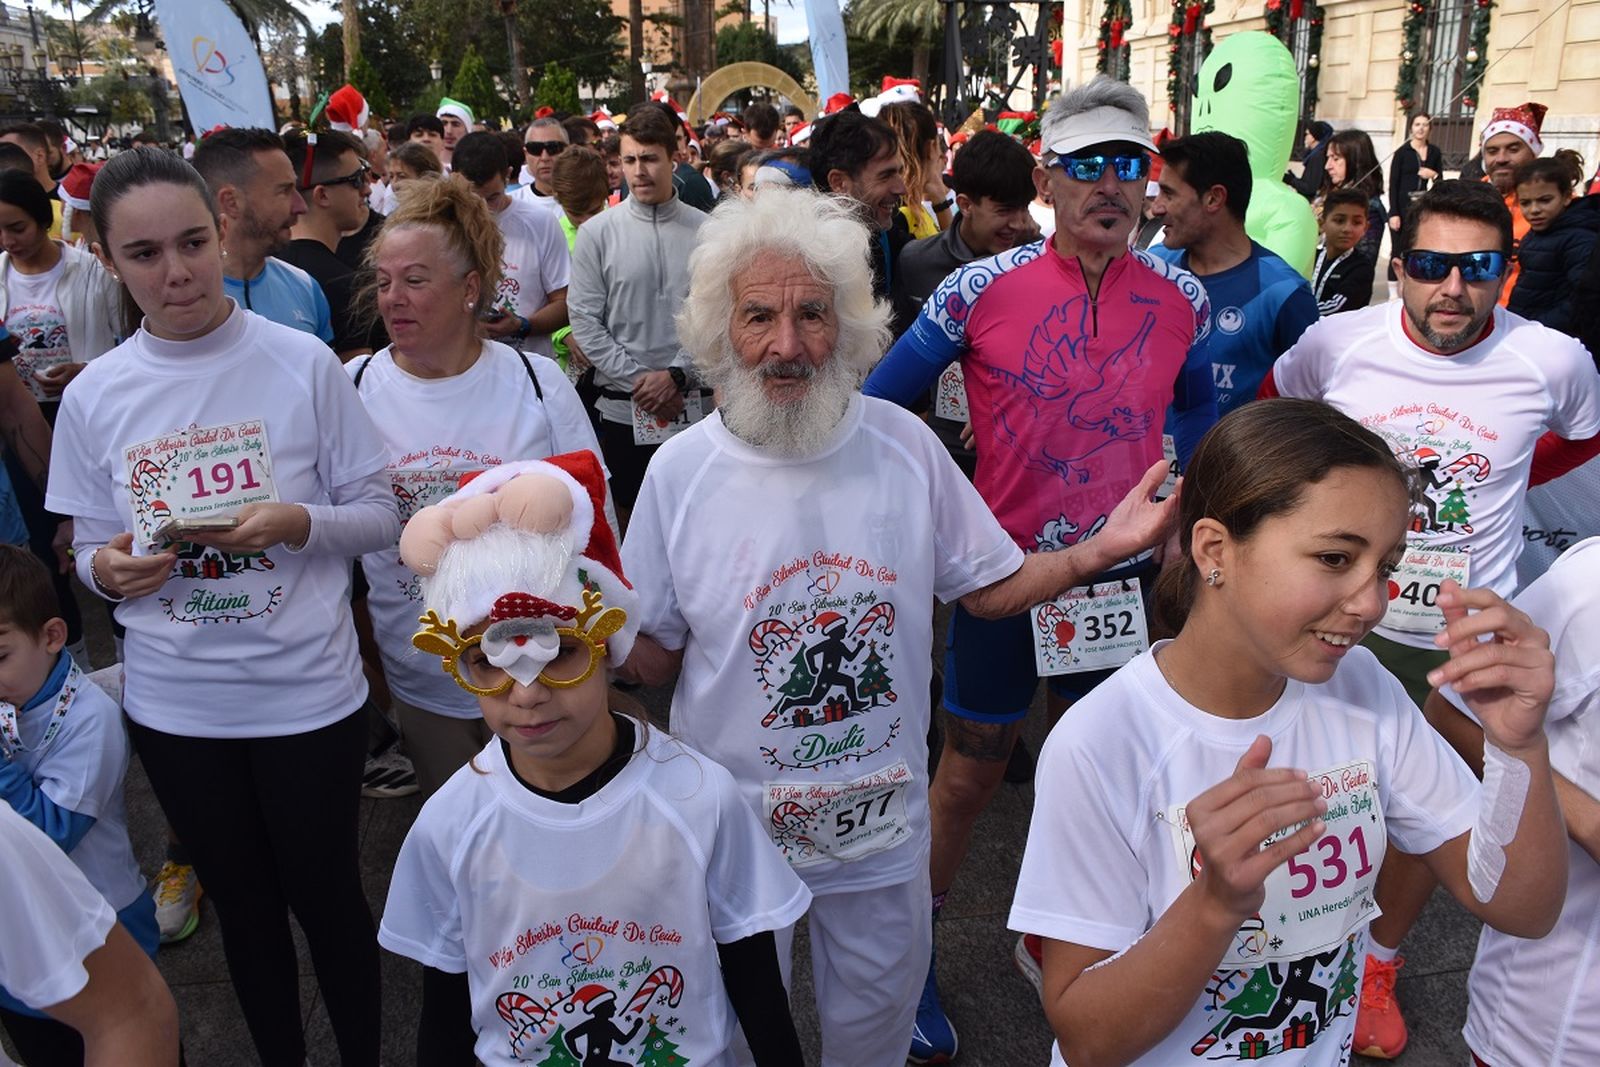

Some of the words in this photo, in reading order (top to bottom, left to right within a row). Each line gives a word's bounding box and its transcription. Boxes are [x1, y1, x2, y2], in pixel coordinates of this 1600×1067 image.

[1426, 402, 1459, 422] Ciudad
[1459, 415, 1474, 431] De
[154, 439, 187, 457] Silvestre
[190, 429, 219, 447] Ciudad
[220, 427, 235, 442] De
[238, 424, 262, 438] Ceuta
[210, 445, 239, 458] Silvestre
[241, 438, 263, 451] Baby
[188, 458, 261, 499] 191
[772, 558, 810, 587] Silvestre
[812, 550, 853, 570] Ciudad
[855, 559, 875, 577] De
[184, 589, 251, 615] Aitana
[788, 600, 807, 615] San
[810, 596, 848, 612] Silvestre
[852, 590, 878, 605] Baby
[1084, 610, 1136, 641] 352
[793, 724, 866, 762] Dudú
[1321, 775, 1339, 799] De
[1341, 769, 1368, 792] Ceuta
[835, 789, 896, 837] 577
[1350, 791, 1372, 815] Baby
[1287, 826, 1373, 899] 531
[516, 923, 563, 955] Silvestre
[567, 913, 619, 936] Ciudad
[622, 921, 646, 942] De
[650, 924, 682, 944] Ceuta
[537, 973, 562, 988] San
[566, 966, 615, 987] Silvestre
[619, 956, 653, 977] Baby
